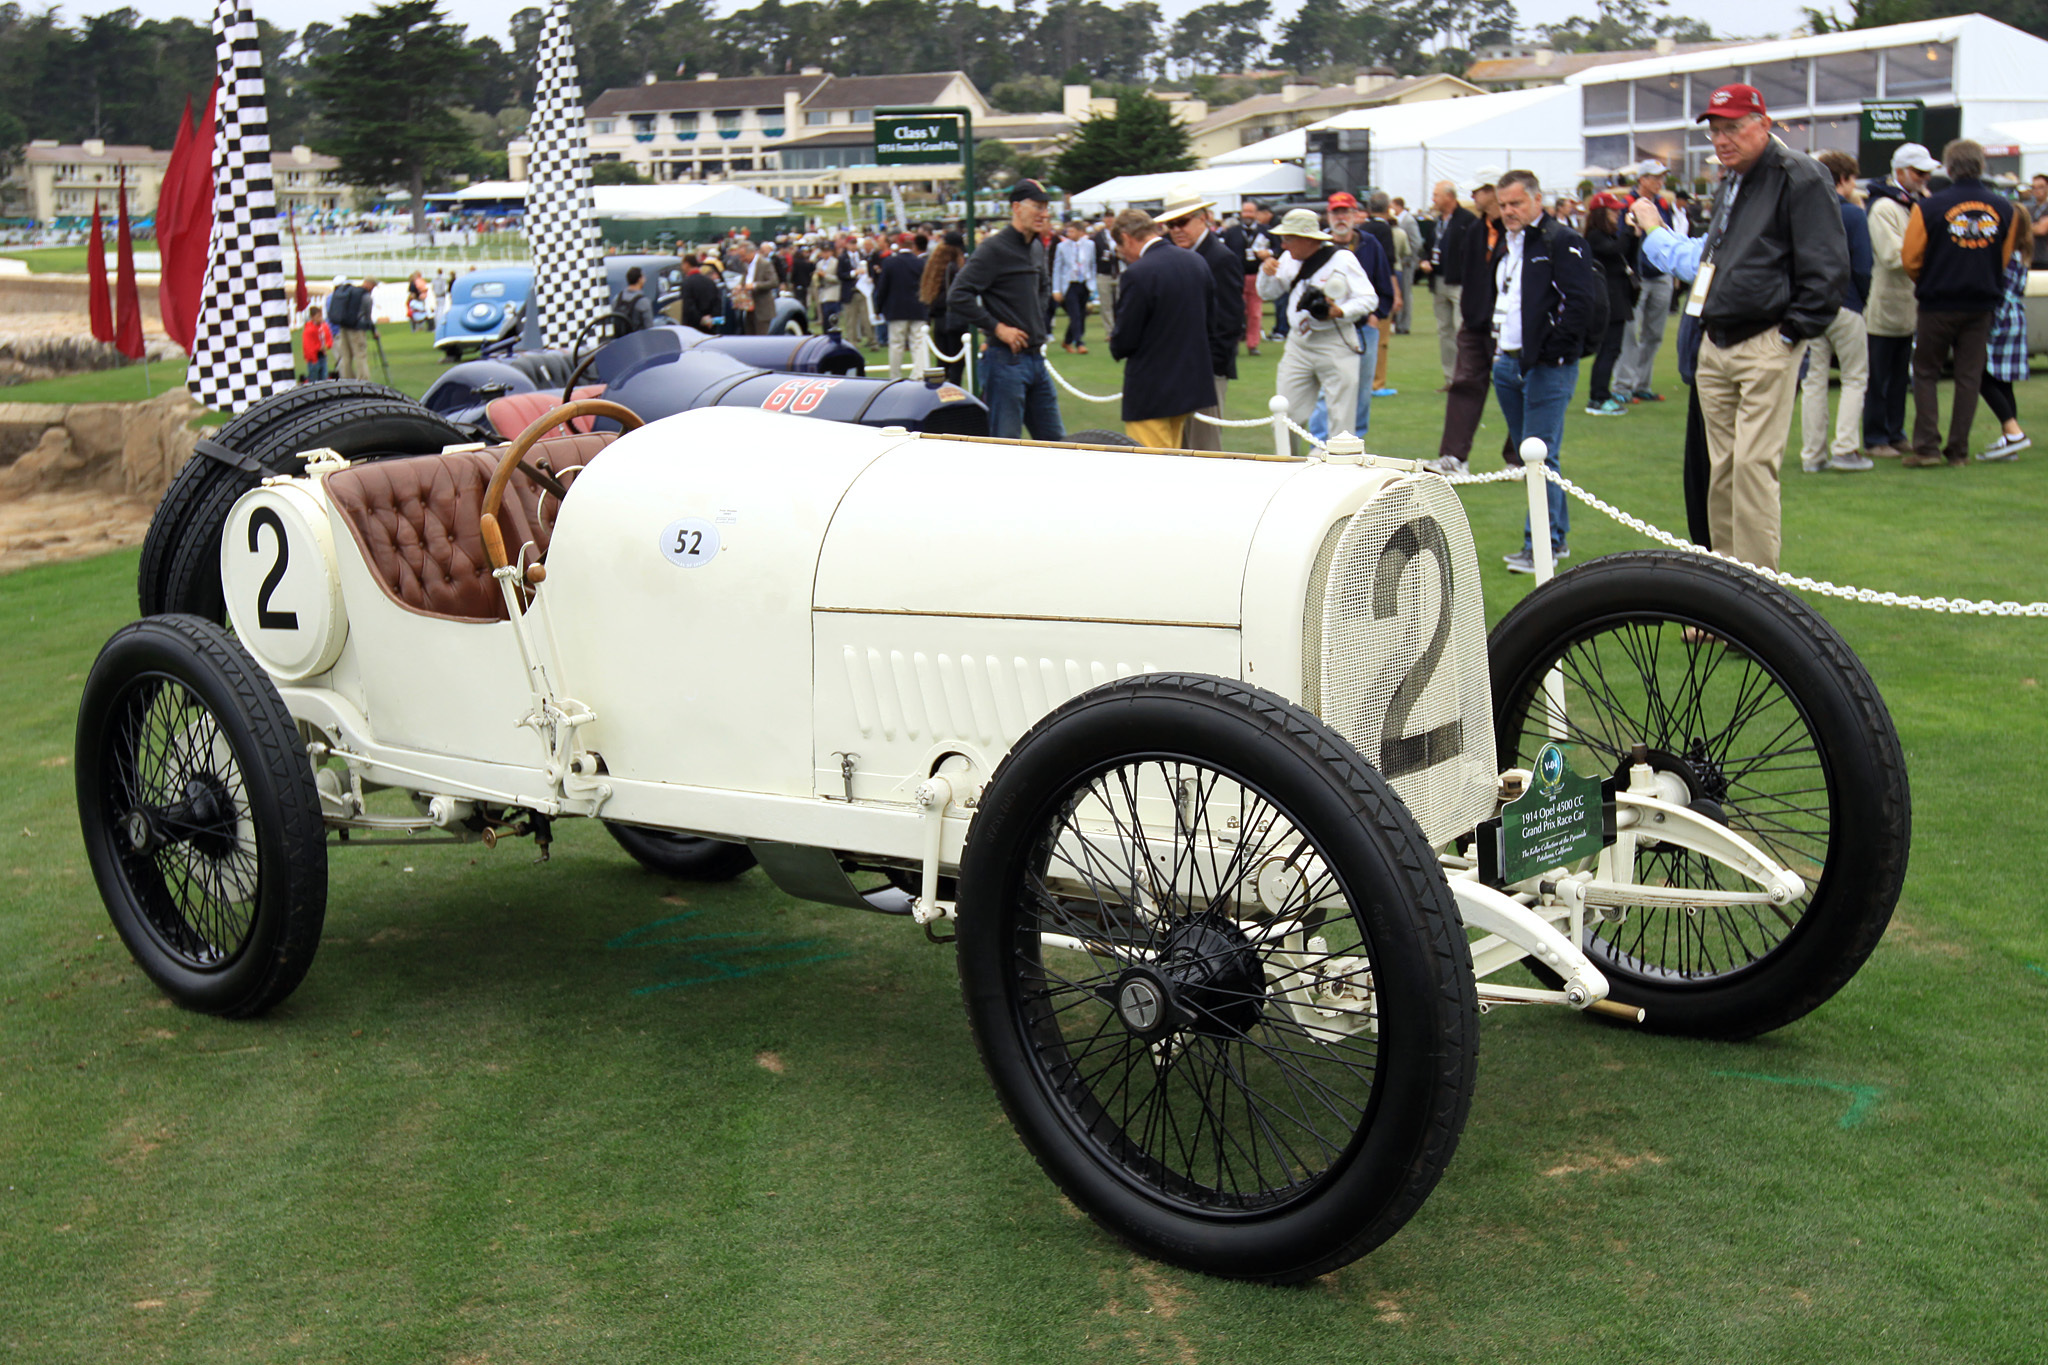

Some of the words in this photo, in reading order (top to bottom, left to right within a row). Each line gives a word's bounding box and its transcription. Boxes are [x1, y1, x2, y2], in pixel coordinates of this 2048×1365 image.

[894, 126, 928, 140] Class
[928, 126, 940, 138] V
[878, 143, 895, 153] 1914
[896, 142, 920, 152] French
[921, 141, 943, 152] Grand
[943, 141, 958, 150] Prix
[761, 379, 843, 414] 66
[674, 529, 702, 555] 52
[247, 506, 300, 630] 2
[1371, 516, 1464, 777] 2
[1544, 759, 1558, 771] V-04
[1522, 810, 1538, 824] 1914
[1539, 803, 1555, 820] Opel
[1556, 799, 1573, 812] 4500
[1574, 795, 1584, 807] CC
[1522, 822, 1542, 838] Grand
[1543, 819, 1555, 831] Prix
[1557, 815, 1572, 827] Race
[1574, 810, 1585, 821] Car
[1541, 841, 1558, 851] Collection
[1570, 829, 1586, 842] Pyramids
[1555, 845, 1573, 855] California
